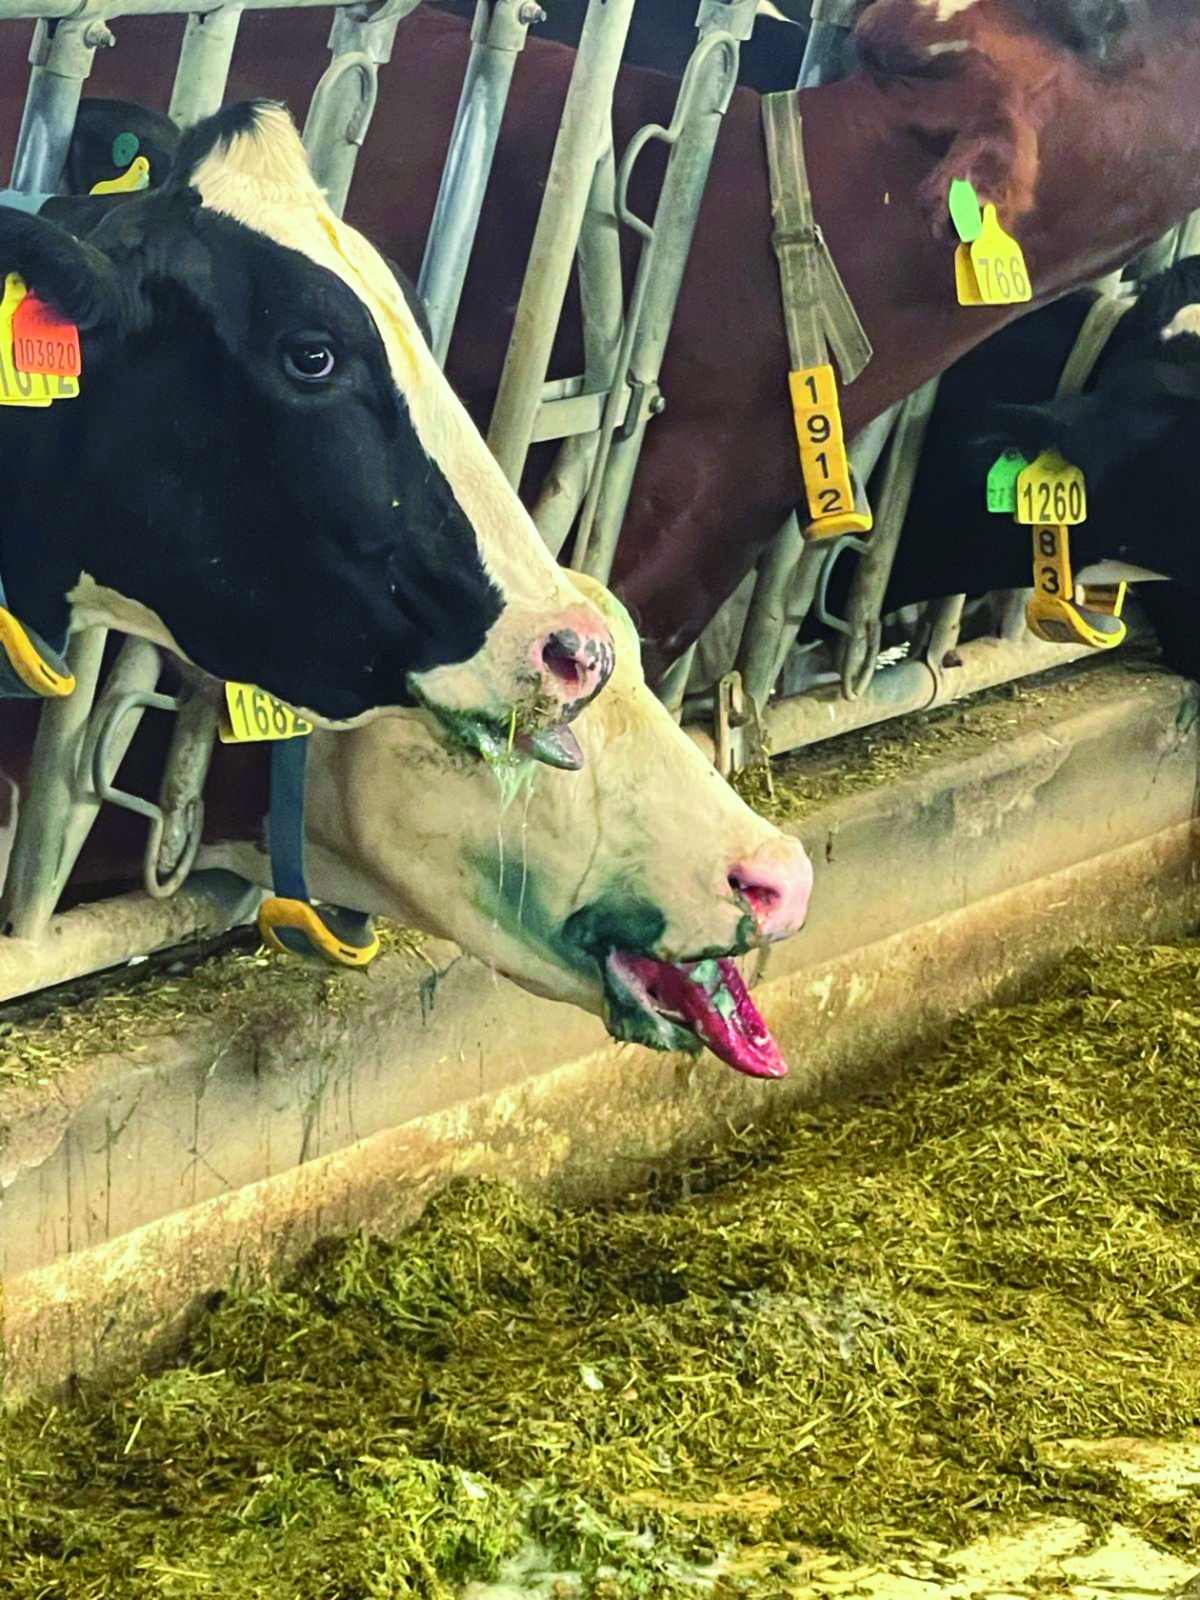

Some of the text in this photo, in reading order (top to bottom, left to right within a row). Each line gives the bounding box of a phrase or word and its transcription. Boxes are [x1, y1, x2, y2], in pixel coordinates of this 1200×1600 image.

[978, 256, 1027, 300] 766
[18, 337, 76, 370] 103820
[804, 375, 842, 513] 1912
[1023, 481, 1082, 522] 1260
